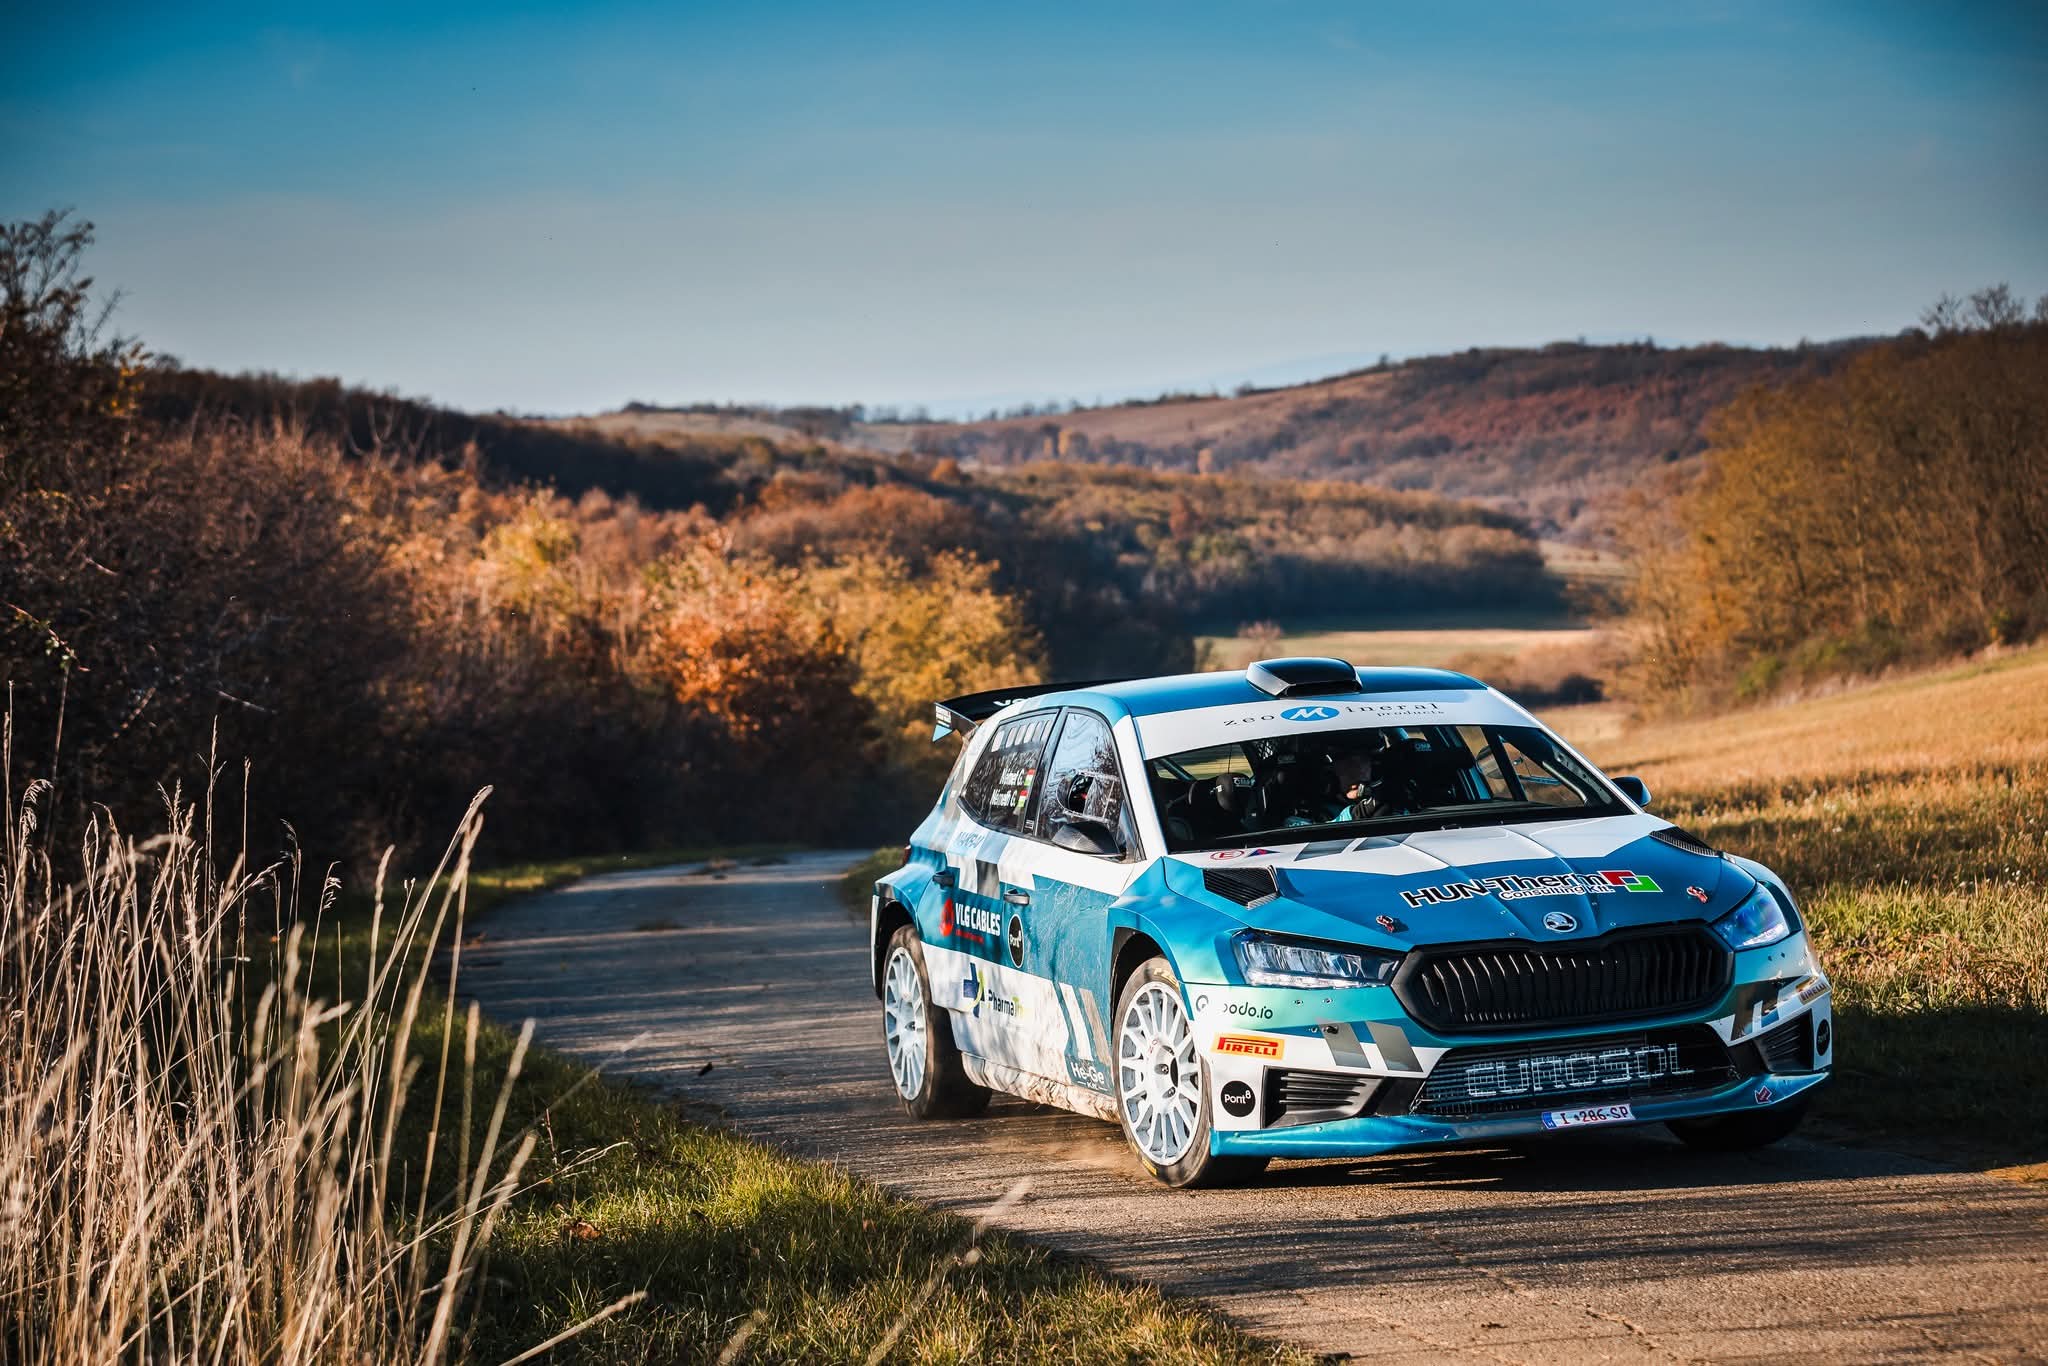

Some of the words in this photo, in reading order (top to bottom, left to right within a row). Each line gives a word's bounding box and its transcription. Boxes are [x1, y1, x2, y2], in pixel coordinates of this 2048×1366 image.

[1400, 873, 1609, 908] HUN-Therm
[1499, 885, 1586, 900] Consulting
[955, 902, 971, 928] VLG
[971, 907, 1001, 936] CABLES
[1801, 983, 1828, 1002] PIRELLI
[1217, 1036, 1279, 1056] PIRELLI
[1070, 1061, 1105, 1084] He-Ge
[1466, 1043, 1695, 1097] EUROSOL
